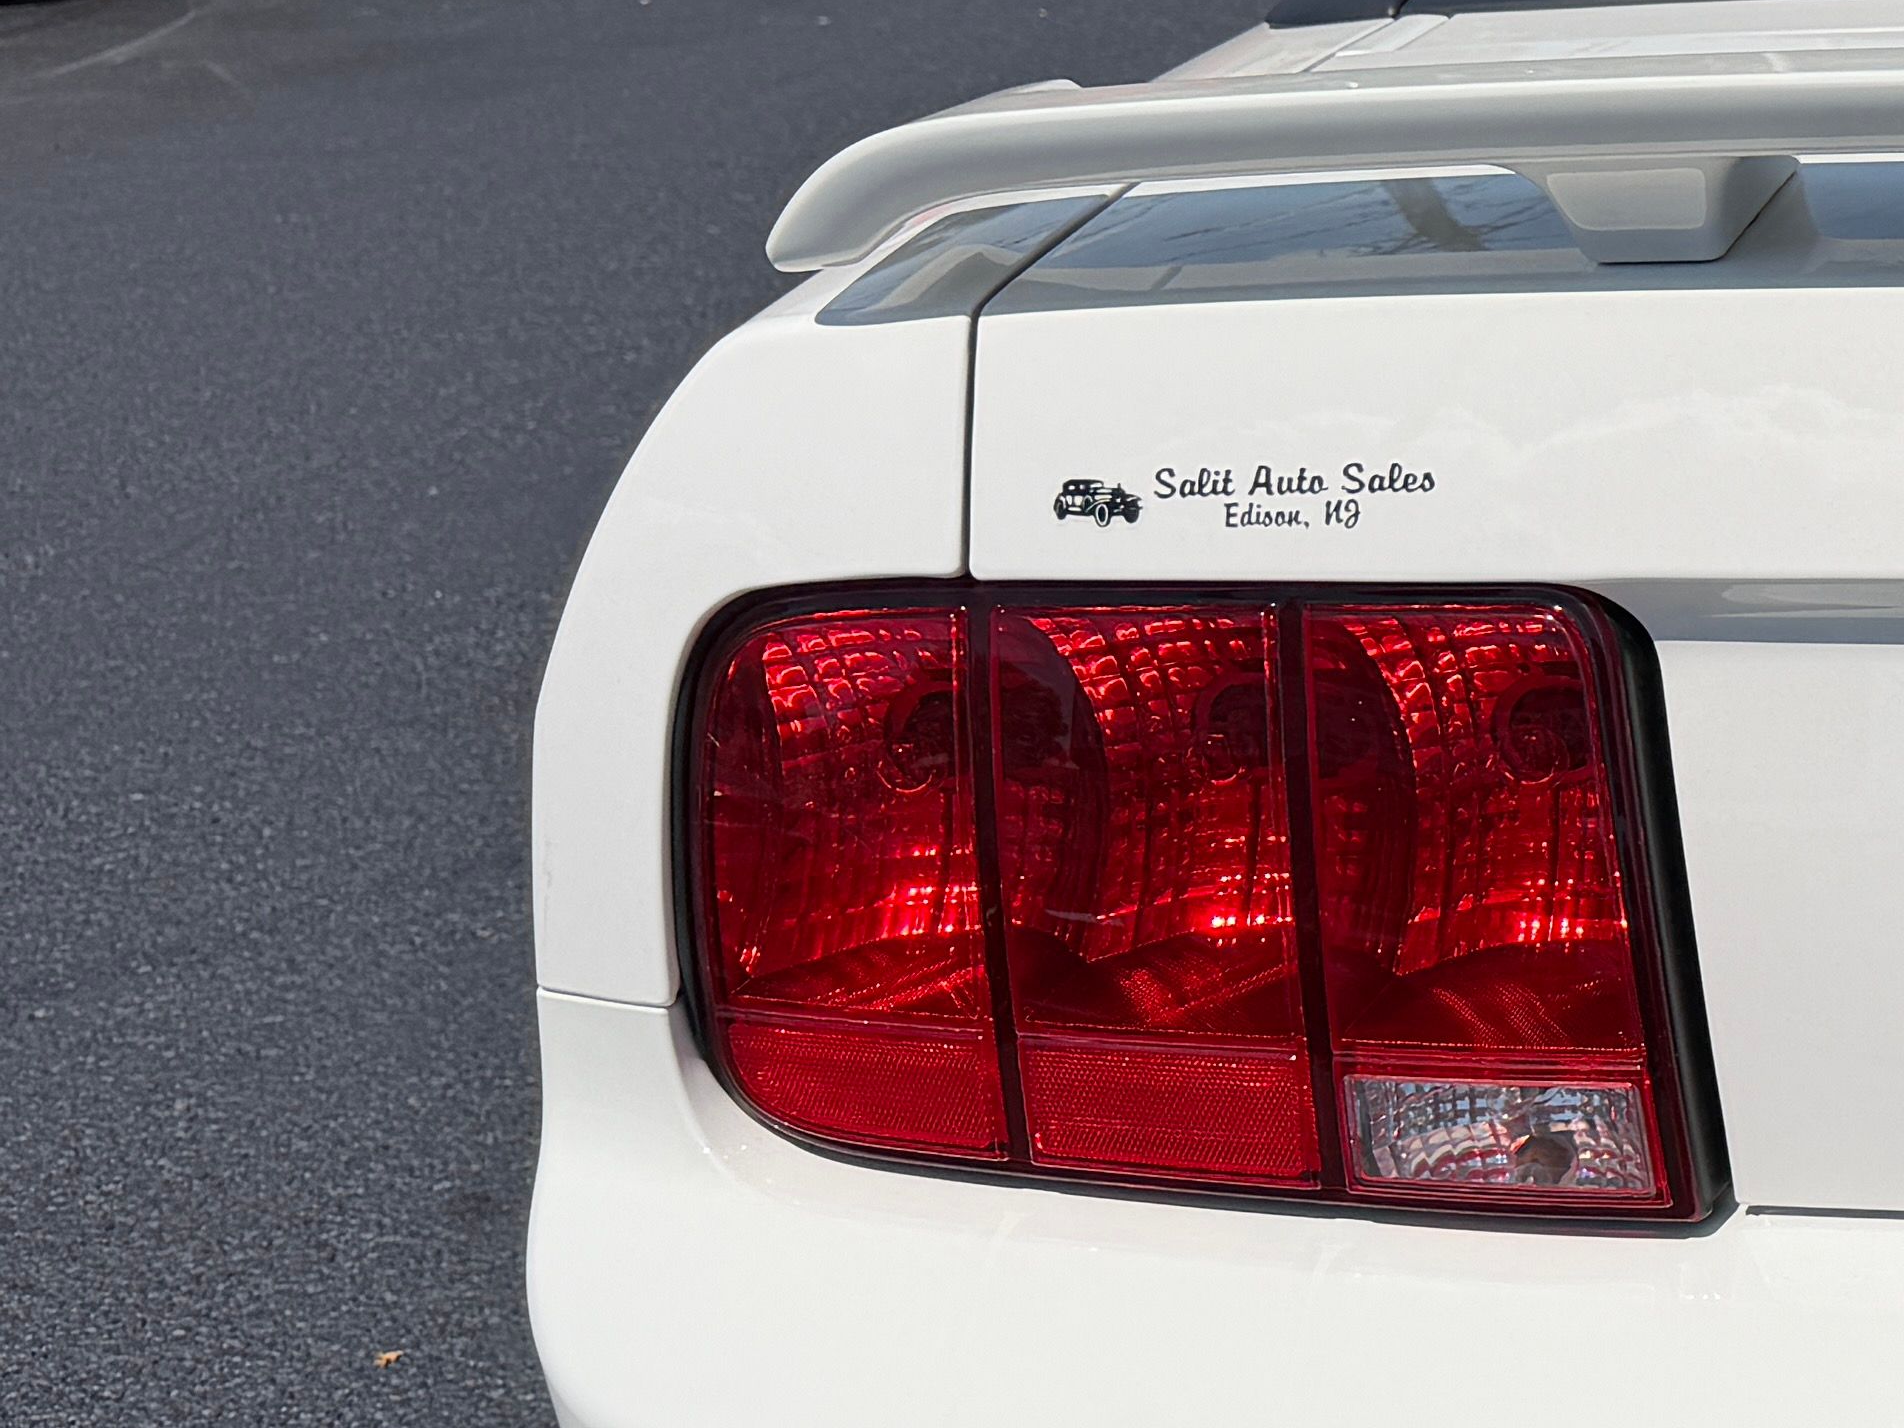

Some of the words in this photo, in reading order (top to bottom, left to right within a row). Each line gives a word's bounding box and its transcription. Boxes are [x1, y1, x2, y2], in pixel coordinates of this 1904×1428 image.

[1153, 467, 1236, 499] Salit
[1248, 465, 1329, 497] Auto
[1341, 462, 1436, 494] Sales
[1224, 502, 1310, 529] Edison,
[1324, 499, 1362, 529] NJ
